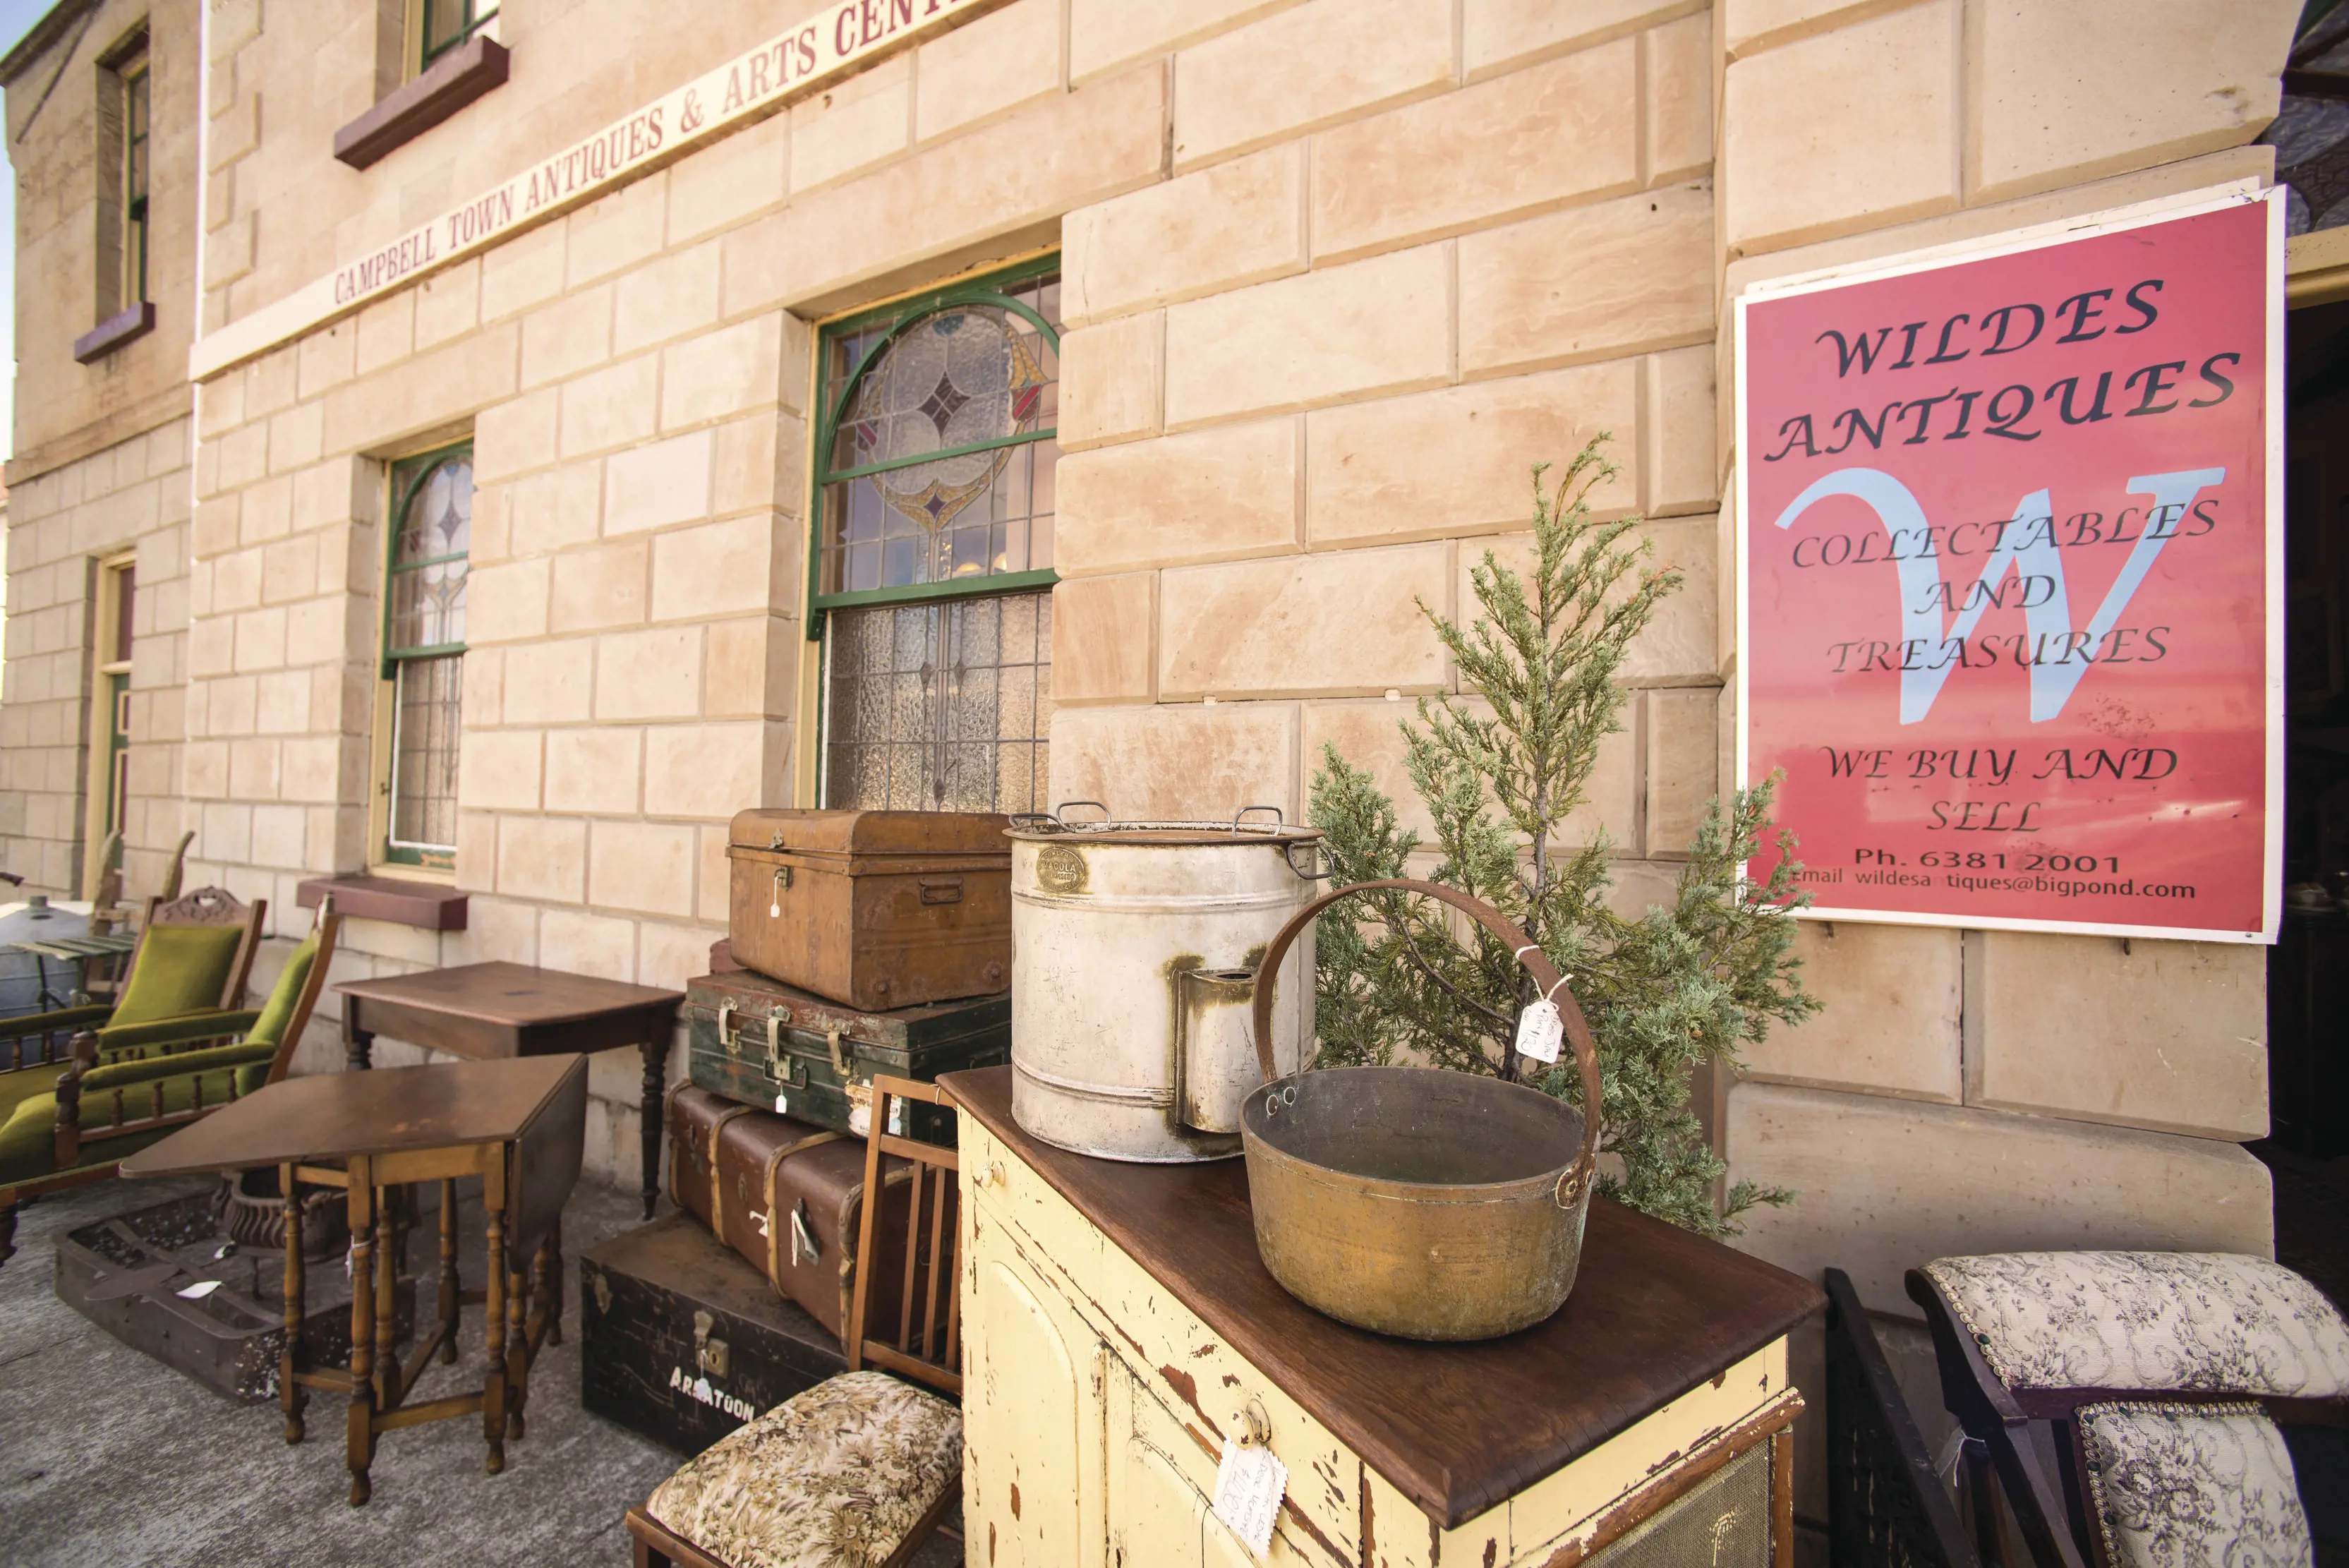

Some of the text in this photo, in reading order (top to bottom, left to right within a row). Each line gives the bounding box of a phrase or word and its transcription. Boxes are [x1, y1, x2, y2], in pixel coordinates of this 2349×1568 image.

[334, 0, 941, 304] CAMPBELL TOWN ANTIQUES & ARTS CEN
[1815, 279, 2164, 379] WILDES
[1763, 352, 2242, 462] ANTIQUES
[1792, 499, 2220, 567] COLLECTABLES
[1774, 466, 2226, 725] W
[1914, 575, 2057, 615] AND
[1827, 626, 2171, 674] TREASURES
[1818, 746, 2178, 785] WE BUY AND
[1926, 800, 2042, 833] SELL
[1854, 848, 2119, 874] Ph. 6381 2001
[1855, 869, 2196, 899] wildesatiques@bigpond.com
[670, 1365, 755, 1423] ARATOON
